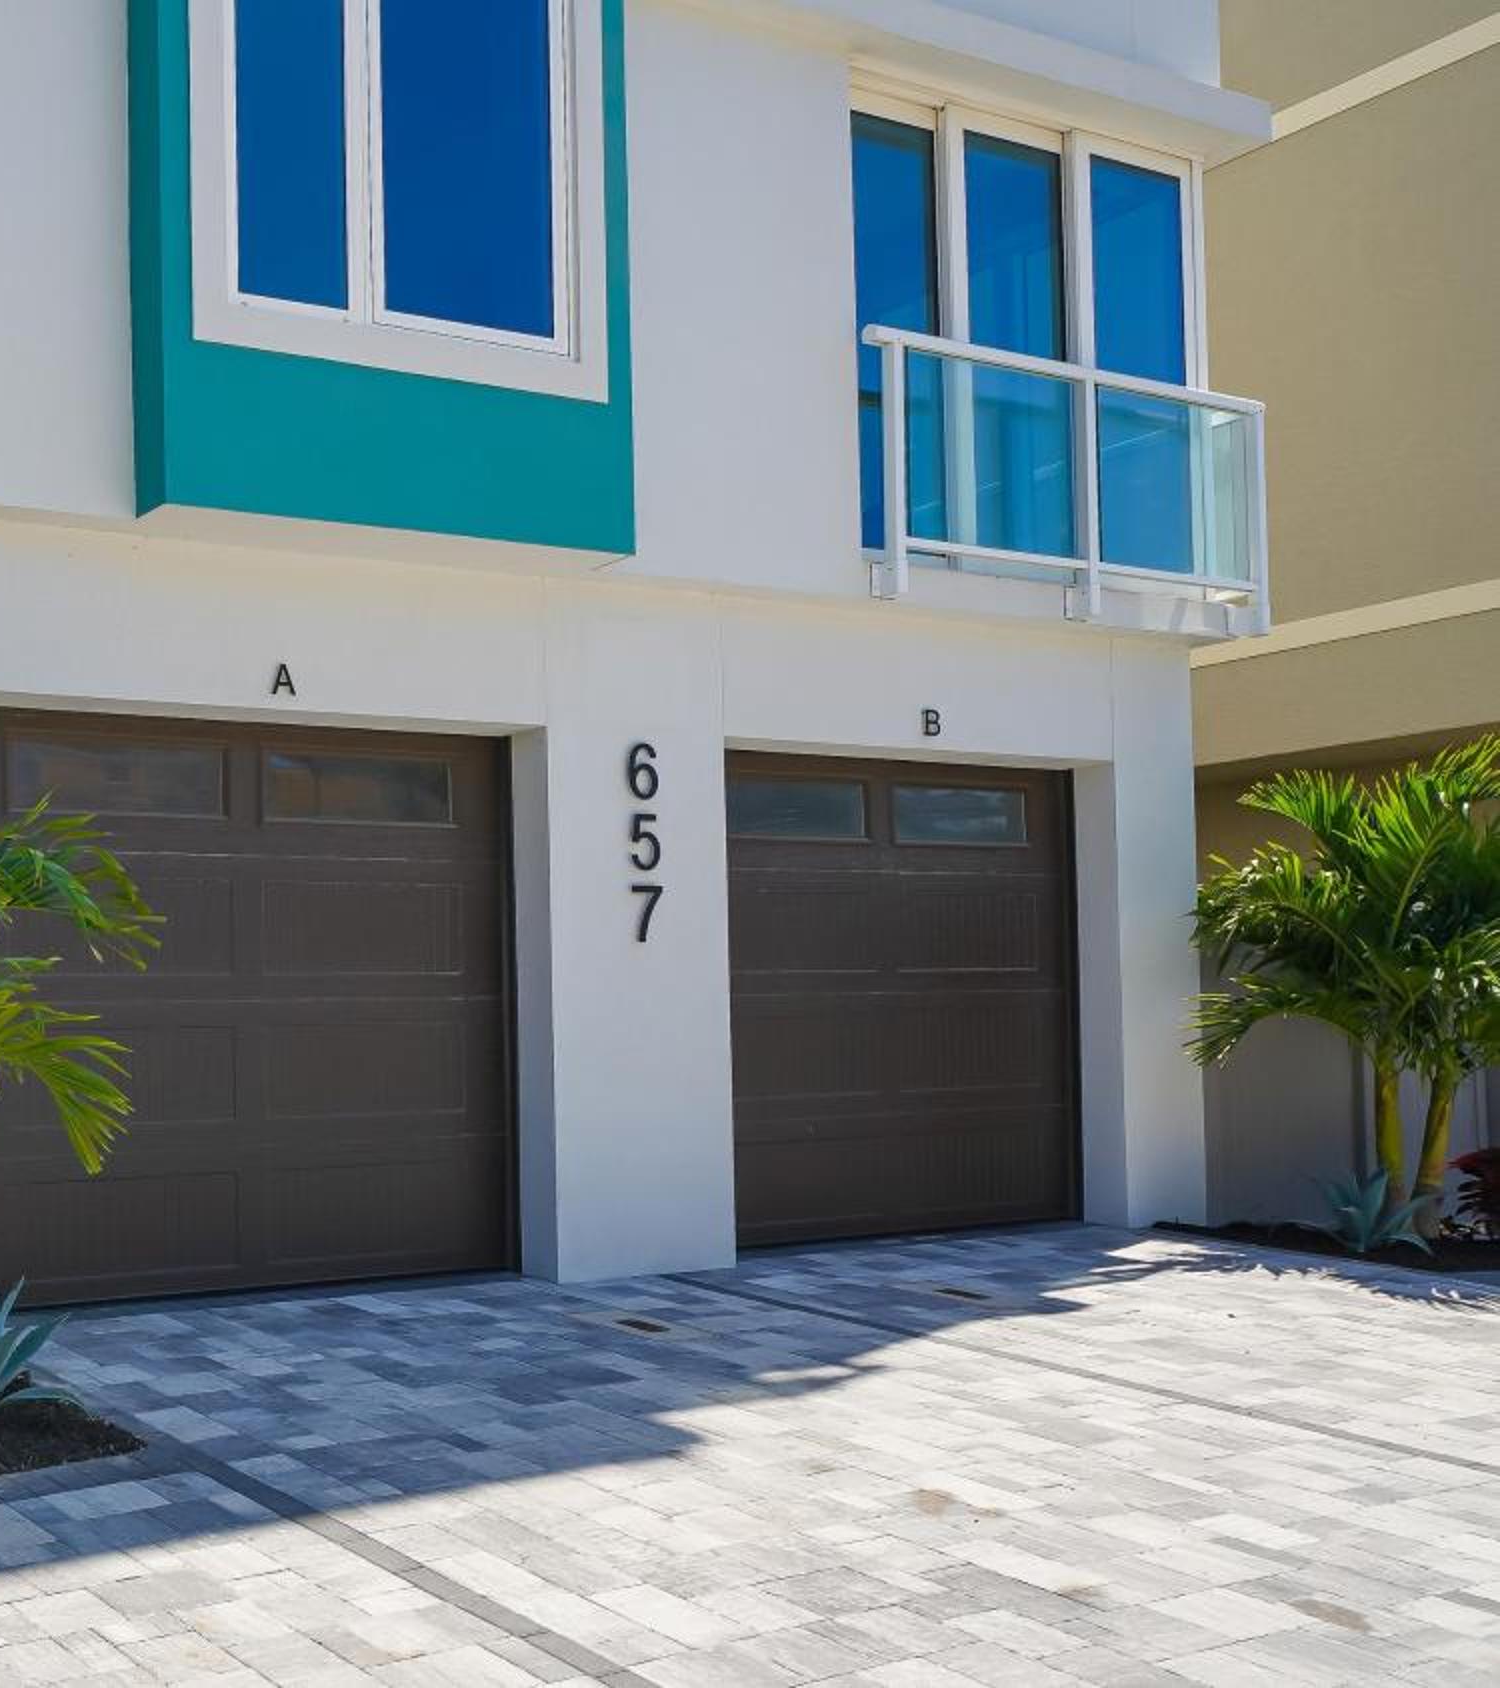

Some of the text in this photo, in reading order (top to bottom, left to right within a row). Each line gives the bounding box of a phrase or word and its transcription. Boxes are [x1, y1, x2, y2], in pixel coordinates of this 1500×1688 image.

[271, 663, 296, 697] A
[921, 708, 942, 737] B
[625, 742, 664, 943] 657
